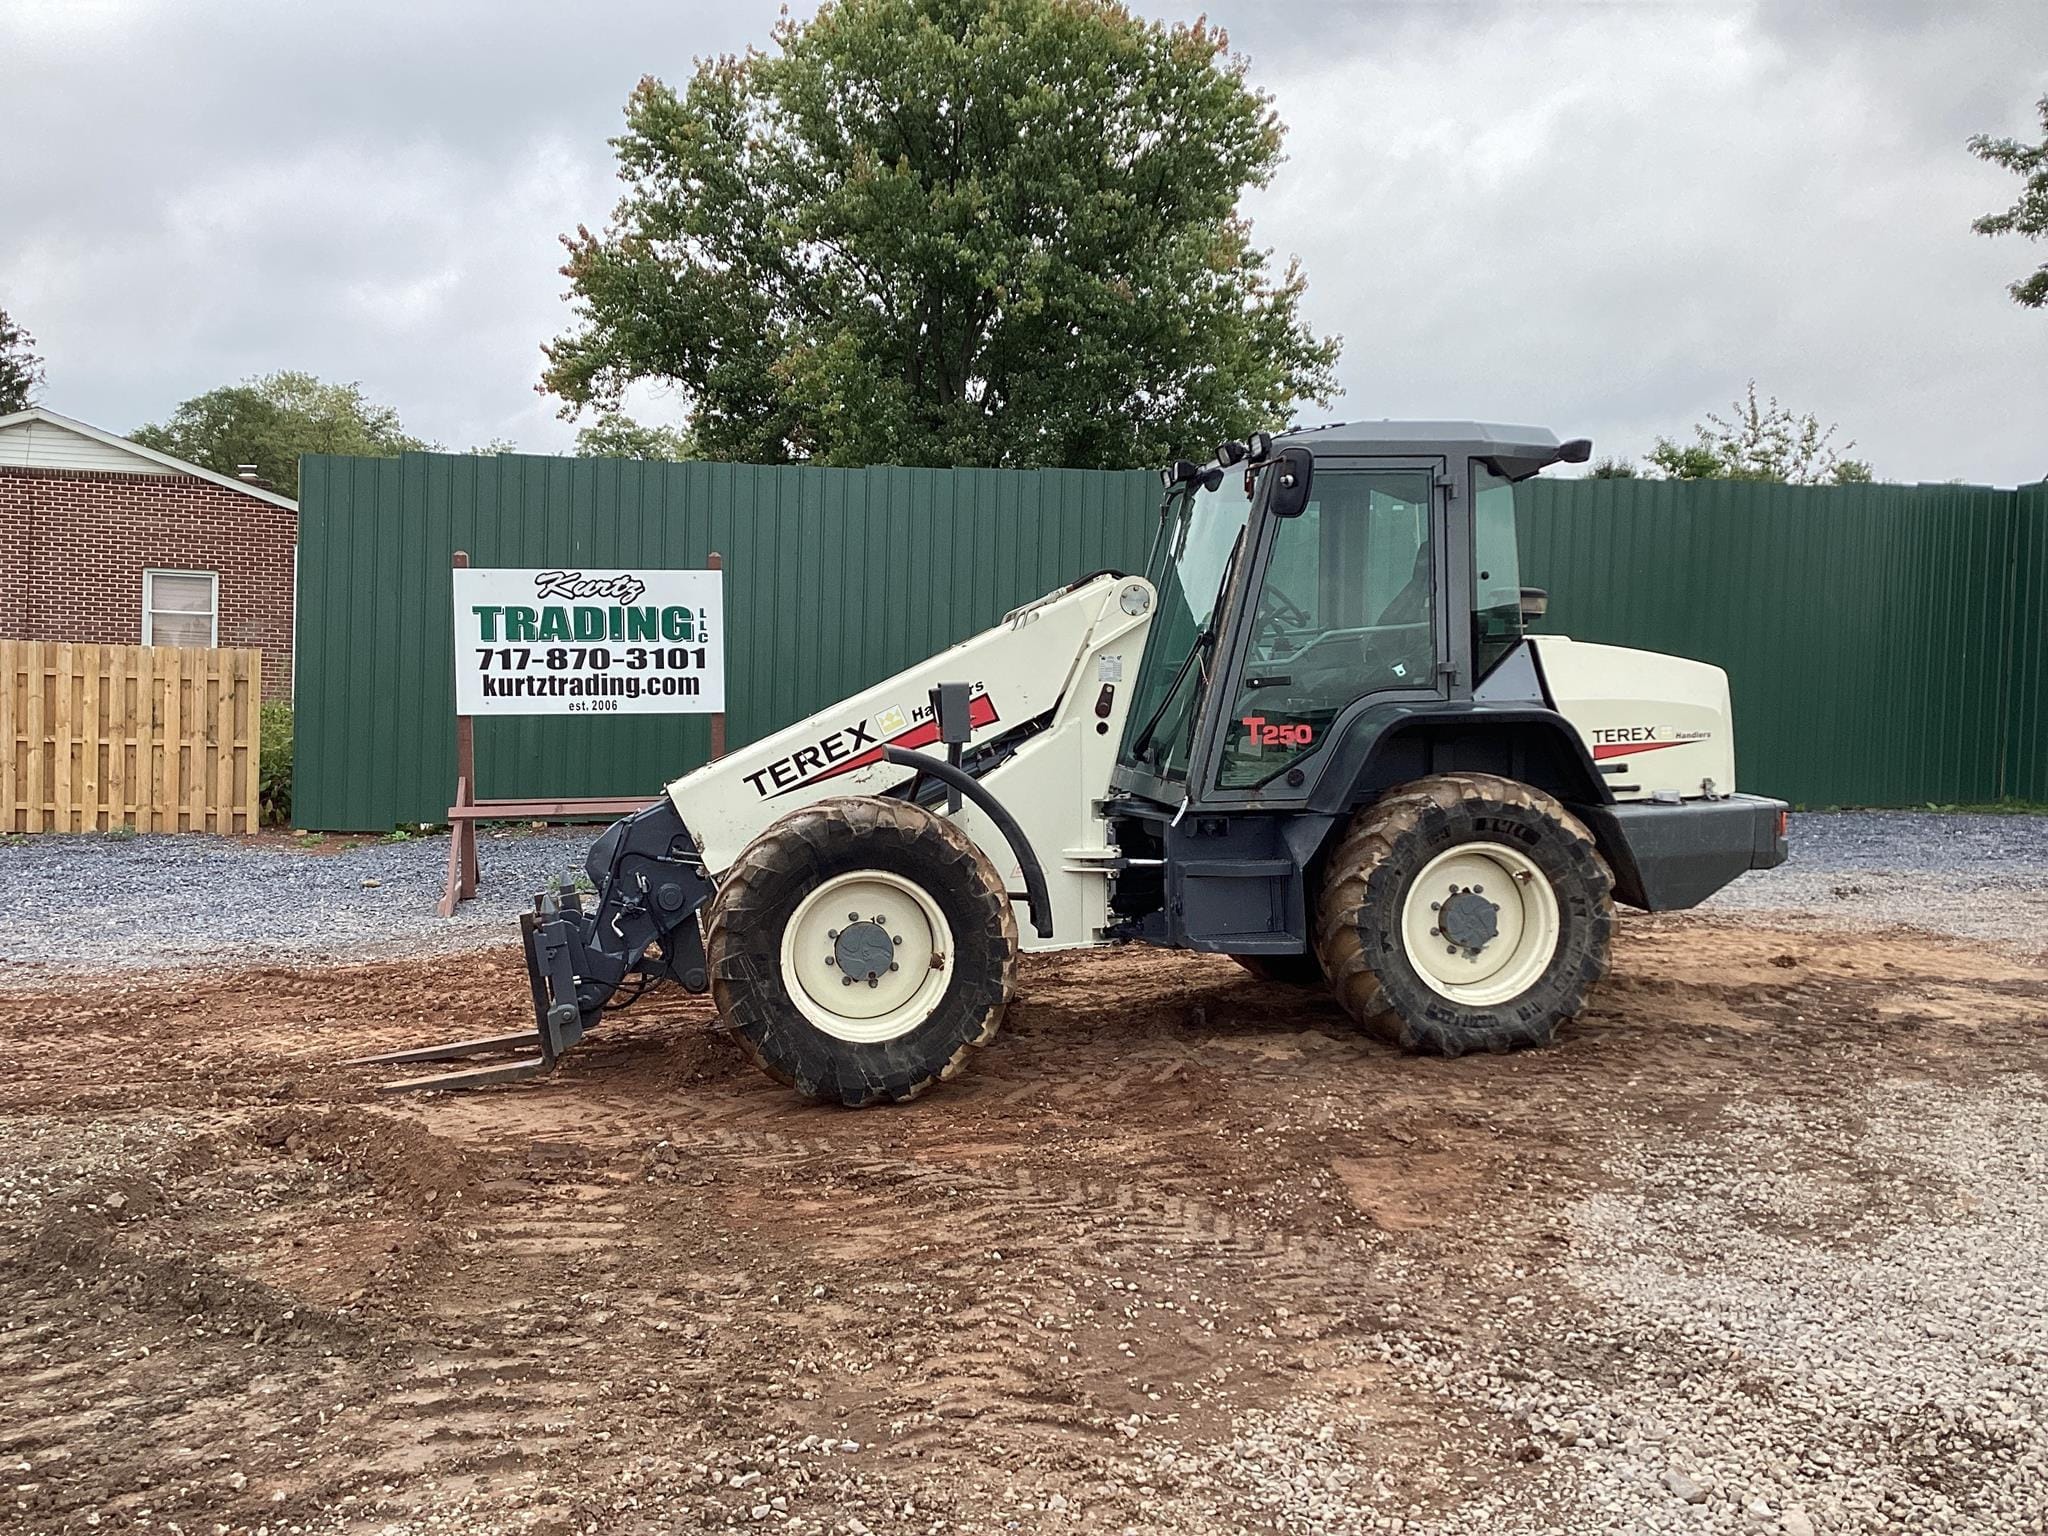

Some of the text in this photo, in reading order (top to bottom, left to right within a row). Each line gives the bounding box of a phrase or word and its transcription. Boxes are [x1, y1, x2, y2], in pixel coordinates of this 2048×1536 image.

[535, 571, 645, 605] Kurtz
[472, 606, 708, 643] TRADING LLC
[475, 648, 706, 670] 717-870-3101
[482, 673, 700, 698] kurtztrading.com
[568, 700, 618, 711] est. 2006
[742, 681, 984, 797] TEREX Hars
[1242, 717, 1312, 745] T250
[1592, 727, 1711, 743] TEREX Handlers
